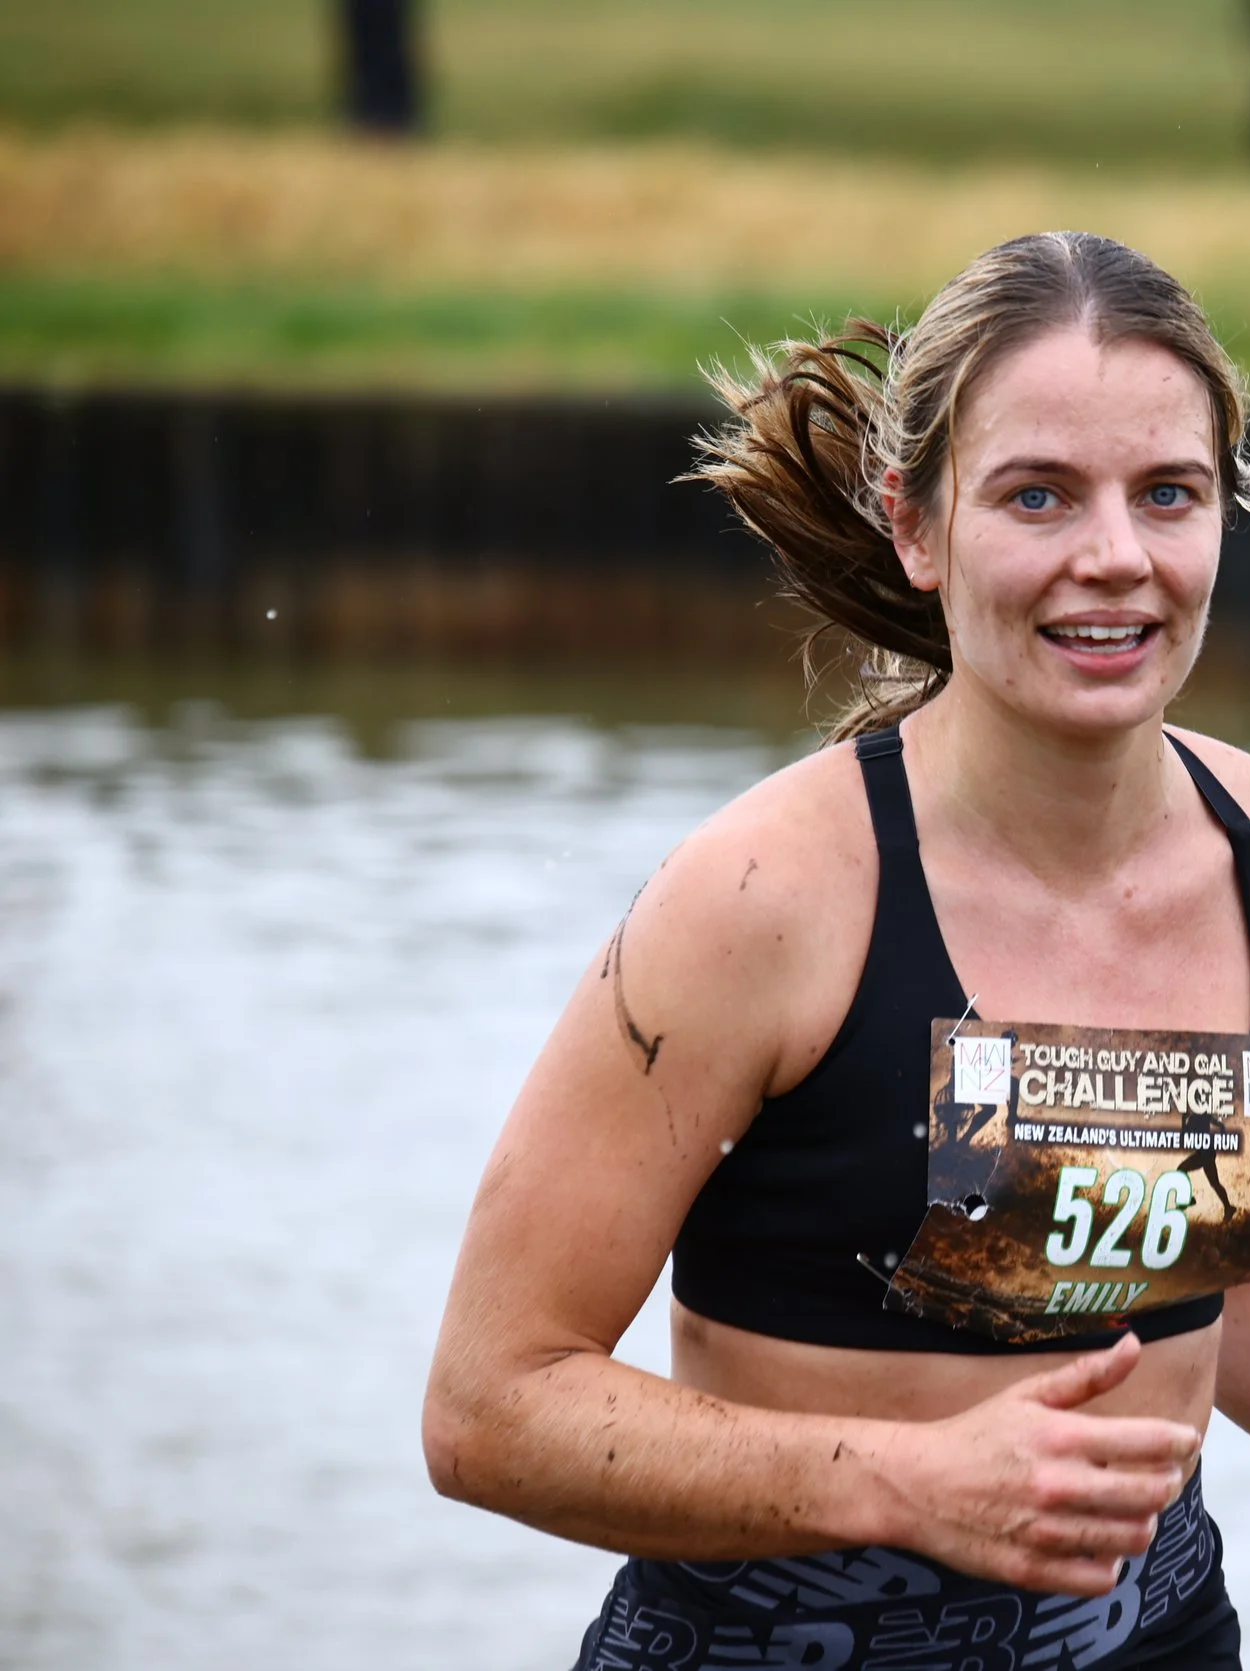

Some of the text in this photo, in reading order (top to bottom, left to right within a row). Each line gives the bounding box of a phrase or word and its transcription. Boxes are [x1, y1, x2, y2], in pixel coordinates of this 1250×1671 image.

[1019, 1043, 1233, 1077] TOUGH GUY AND GAL
[1018, 1069, 1235, 1116] CHALLENGE
[1014, 1123, 1239, 1151] NEW ZEALAND'S ULTIMATE MUD RUN
[1046, 1166, 1193, 1271] 526
[1044, 1281, 1148, 1315] EMILY
